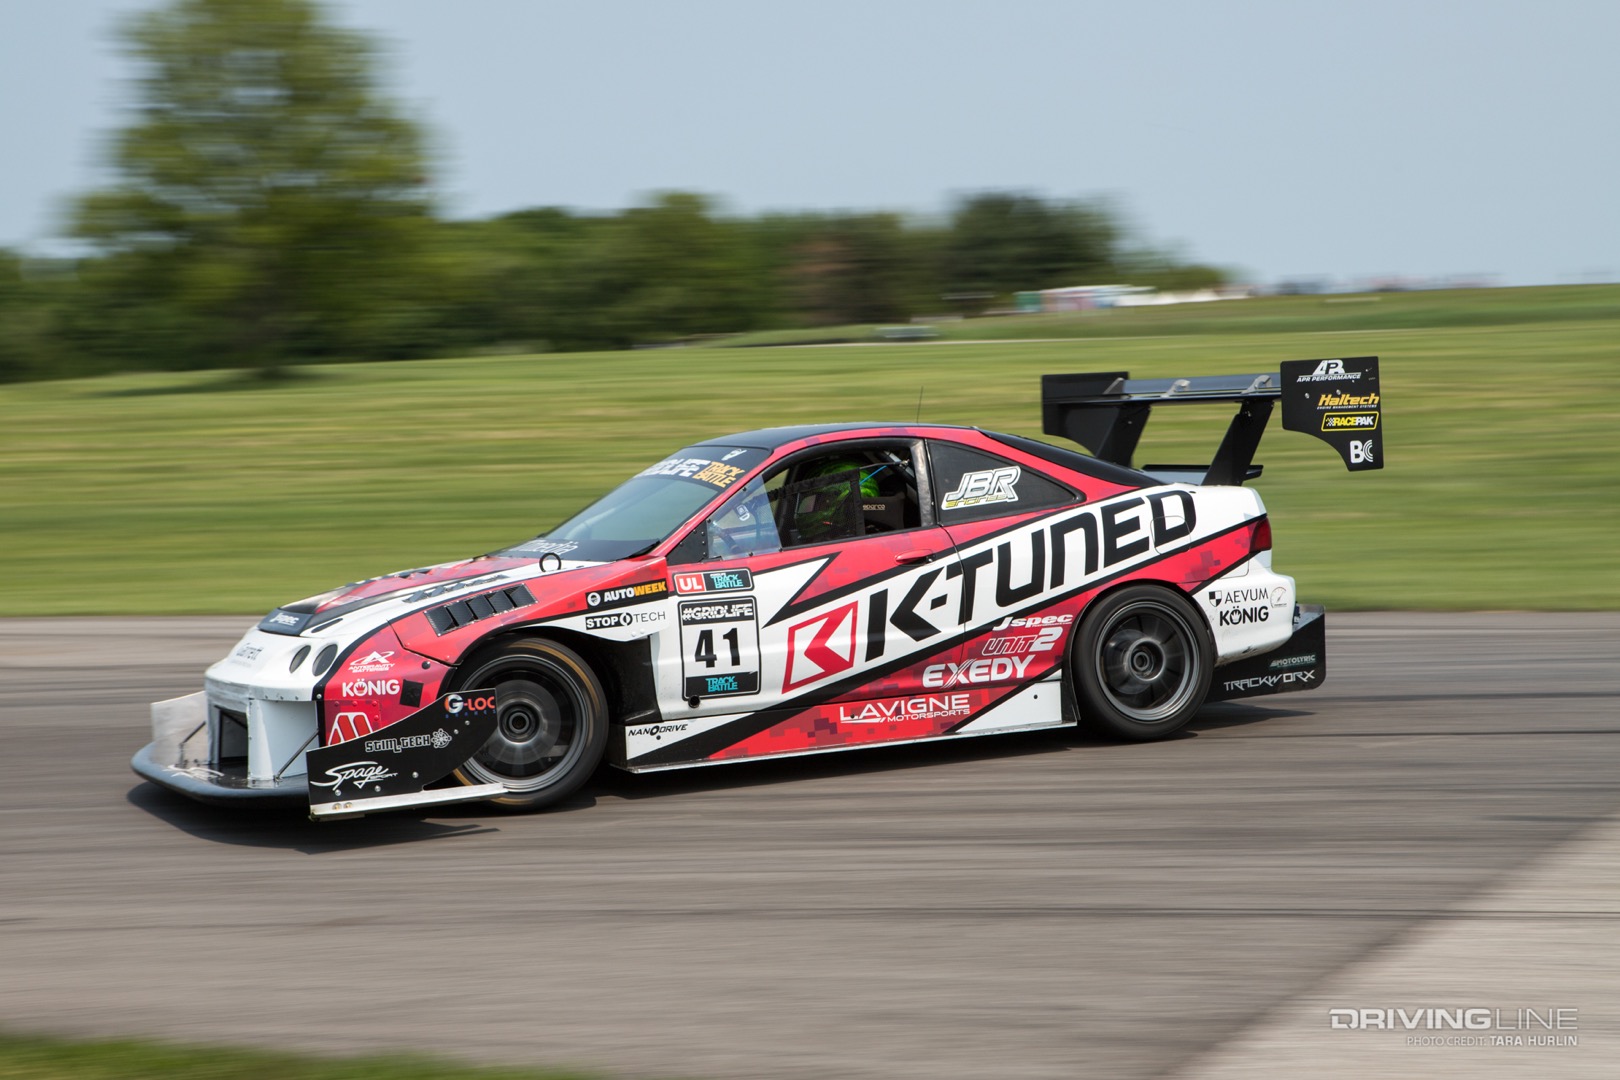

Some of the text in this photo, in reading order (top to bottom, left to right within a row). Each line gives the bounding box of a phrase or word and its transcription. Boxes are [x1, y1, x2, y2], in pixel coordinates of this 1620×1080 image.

[1311, 374, 1361, 382] PERFORMANCE
[1318, 393, 1379, 406] Haltech
[1333, 416, 1374, 427] RACEPAK
[692, 471, 737, 488] BATTLE
[945, 466, 1019, 502] JBR
[678, 577, 702, 591] UL
[711, 574, 739, 583] TRACK
[714, 580, 744, 589] BATTLE
[864, 490, 1197, 664] K-TUNED
[603, 581, 667, 603] AUTOWEEK
[1224, 587, 1269, 604] AEVUM
[682, 603, 754, 621] #GRIDLIFE
[1219, 605, 1269, 627] KÖNIG
[694, 627, 741, 669] 41
[922, 654, 1036, 689] EXEDY
[342, 678, 400, 698] KÖNIG
[705, 675, 736, 686] TRACK
[707, 682, 739, 693] BATTLE
[1223, 669, 1316, 692] TRACKWORX
[444, 693, 496, 714] G-LOC
[839, 694, 970, 721] LAVIGNE
[887, 709, 970, 723] MOTORSPORTS
[628, 724, 688, 736] NANODRIVE
